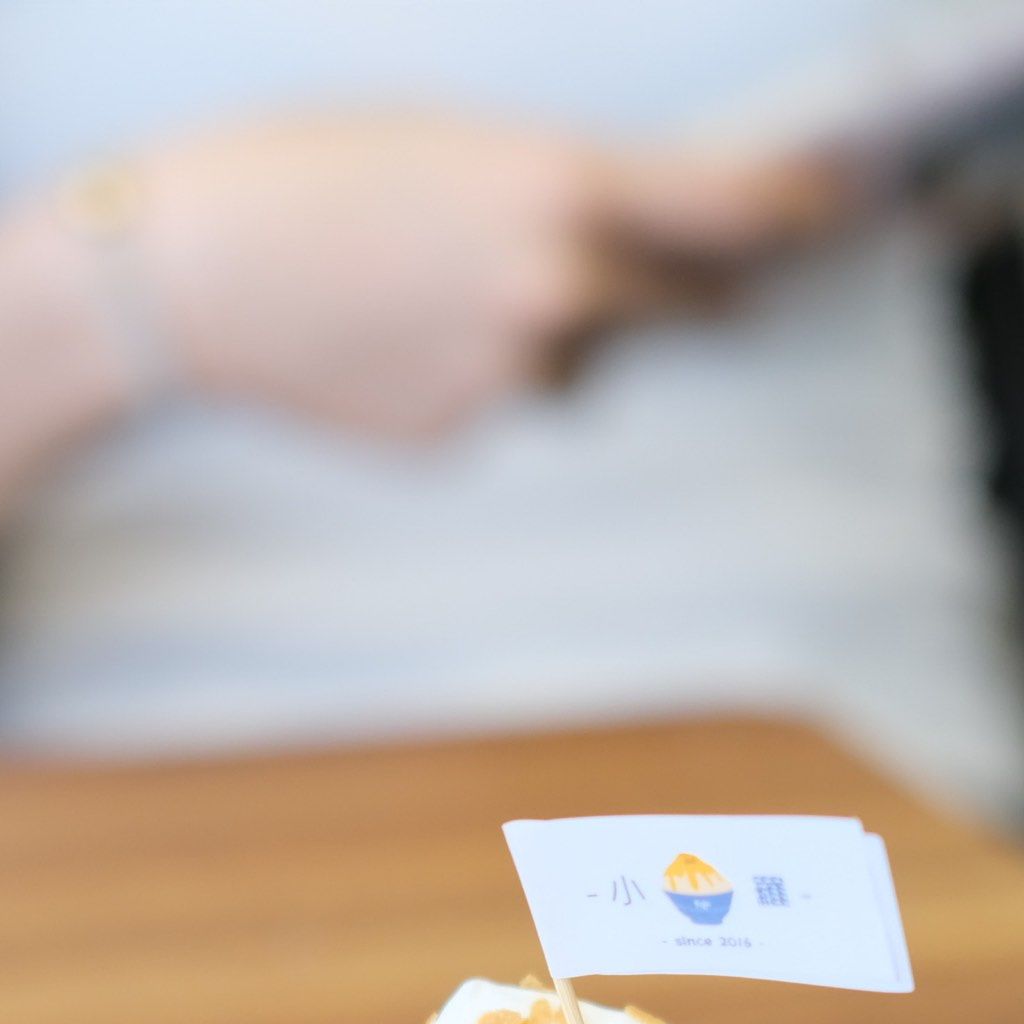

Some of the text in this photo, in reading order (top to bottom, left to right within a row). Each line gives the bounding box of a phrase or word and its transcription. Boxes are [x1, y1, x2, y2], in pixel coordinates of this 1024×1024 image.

[612, 875, 645, 906] 小
[675, 935, 752, 949] since 2016
